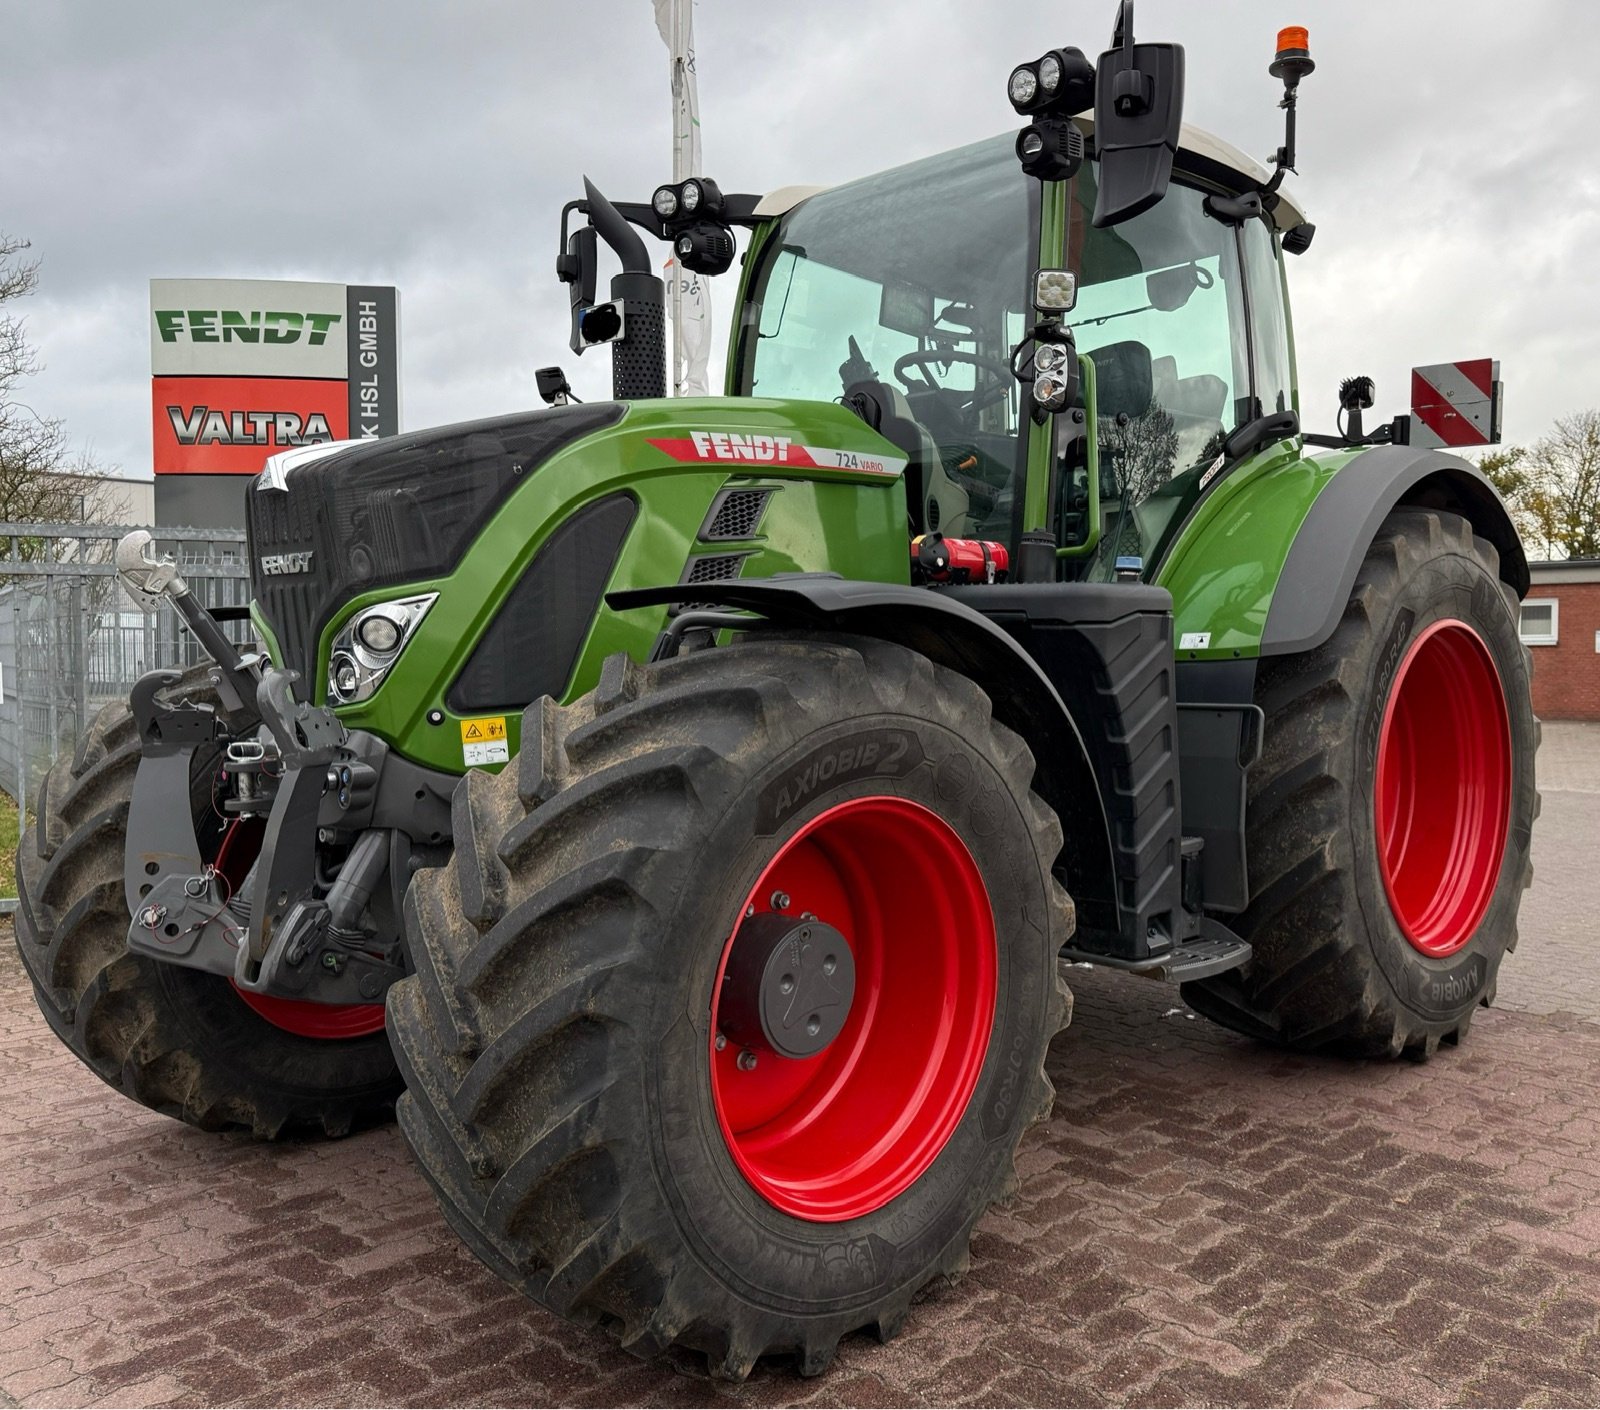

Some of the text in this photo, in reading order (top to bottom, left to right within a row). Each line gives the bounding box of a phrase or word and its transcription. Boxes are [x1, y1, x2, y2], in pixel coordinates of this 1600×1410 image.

[154, 310, 342, 345] FENDT
[359, 301, 379, 368] GMBH
[360, 374, 379, 417] HSL
[166, 406, 335, 446] VALTRA
[690, 431, 884, 472] FENDT 724 VARIO
[261, 550, 313, 576] FENDT
[776, 733, 909, 818] AXIOBIB 2
[1431, 964, 1478, 1001] AXIOBIB
